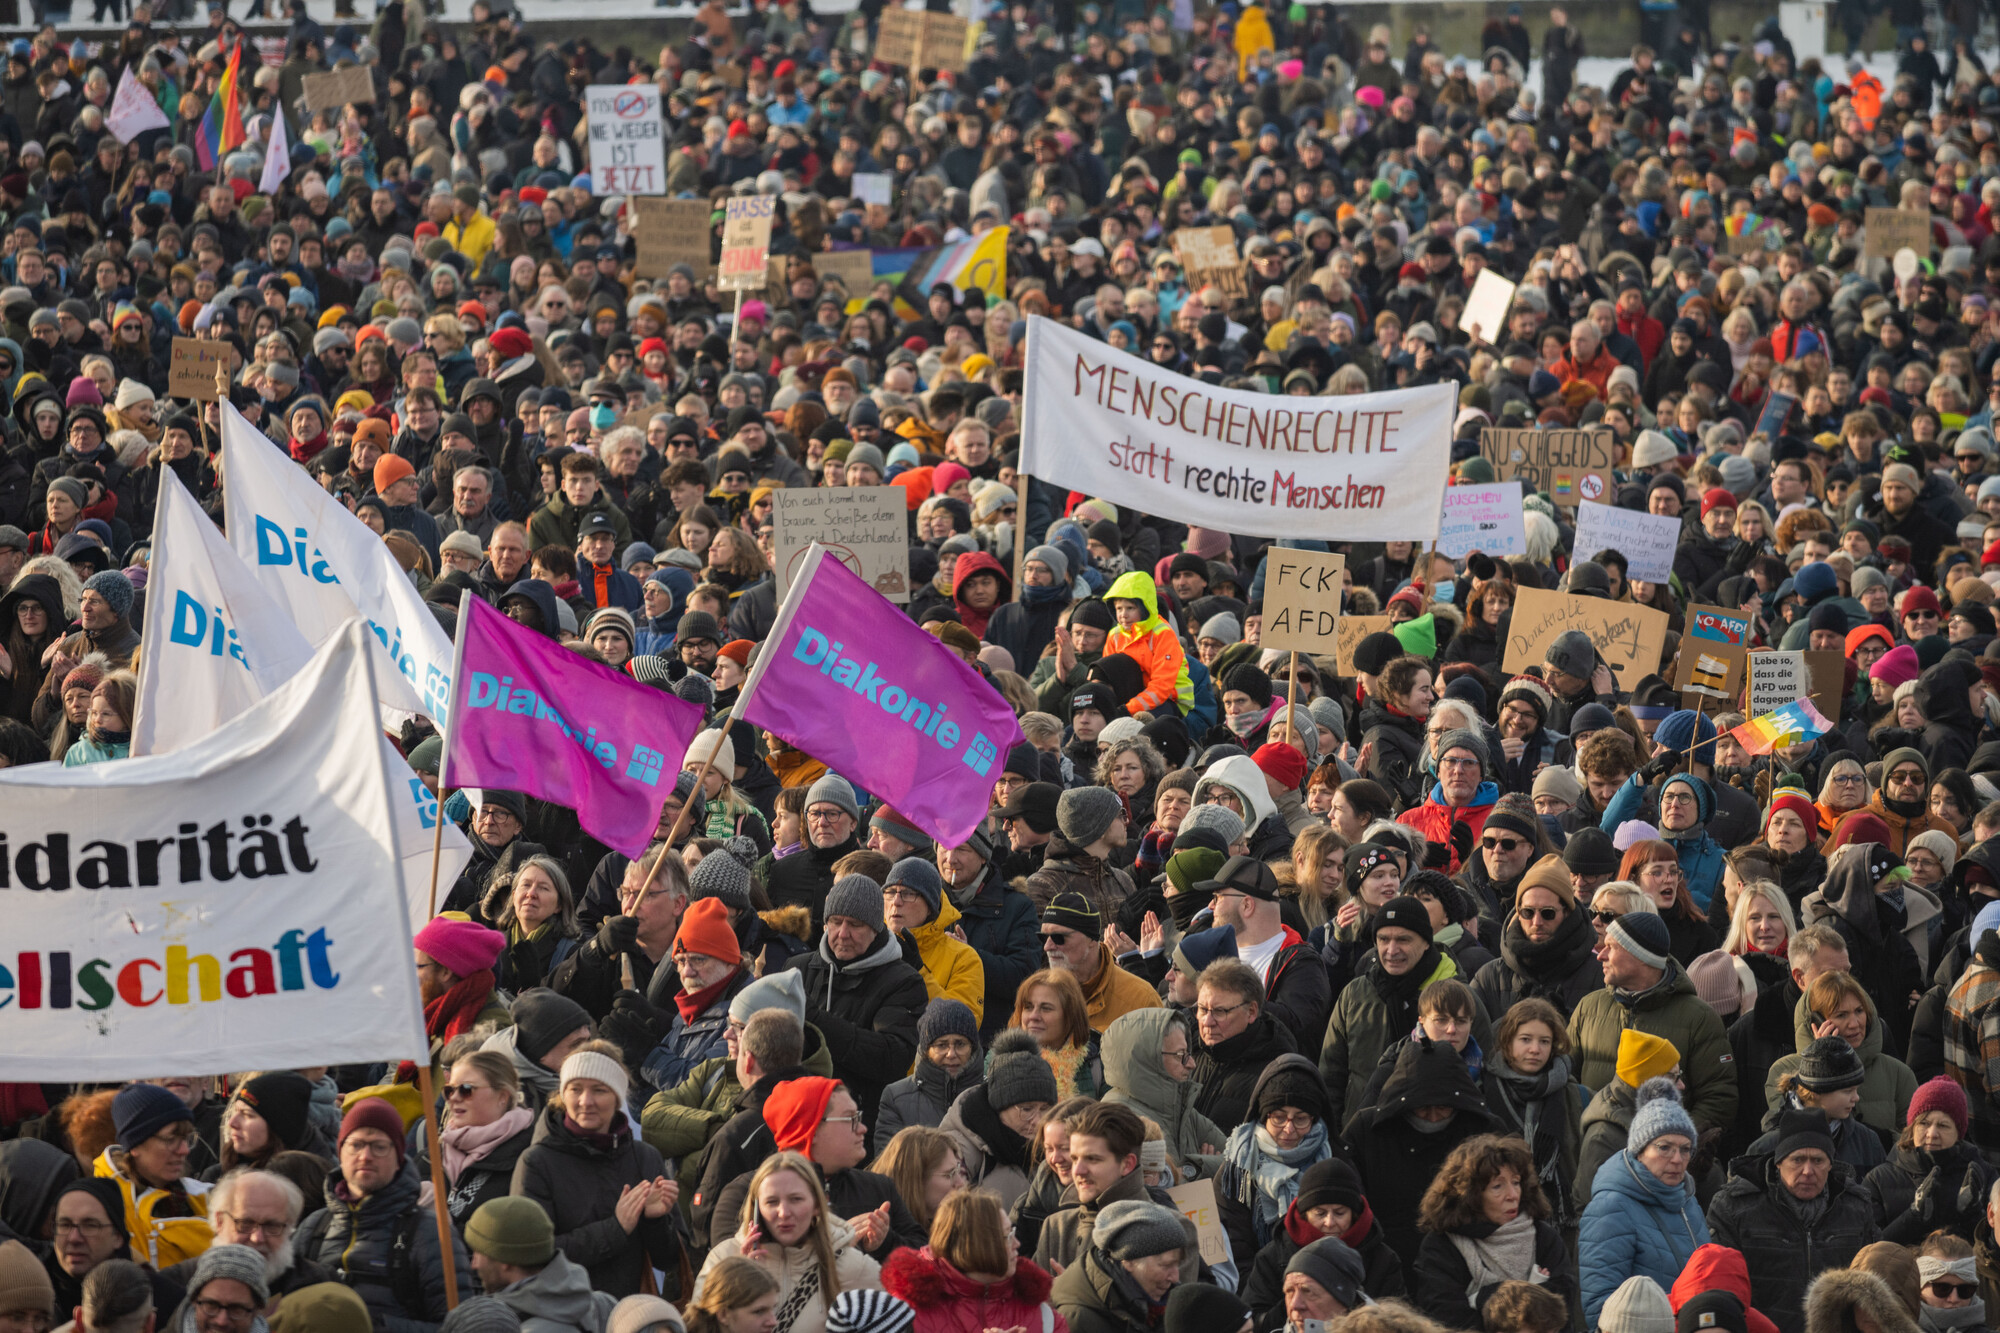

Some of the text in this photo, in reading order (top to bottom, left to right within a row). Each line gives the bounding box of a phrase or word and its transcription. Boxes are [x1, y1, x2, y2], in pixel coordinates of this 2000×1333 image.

[612, 121, 659, 140] WIEDER
[612, 143, 637, 164] IST
[600, 165, 655, 192] JETZT
[727, 196, 773, 220] HASS
[1075, 353, 1403, 454] MENSCHENRECHTE
[1481, 430, 1511, 466] NU
[1108, 435, 1386, 511] statt rechte Menschen
[776, 489, 878, 509] Von euch kommt nur
[1444, 492, 1502, 507] ENSCHEN
[781, 510, 817, 527] braune
[872, 508, 895, 522] denn
[1580, 504, 1600, 525] Die
[783, 529, 797, 546] ihr
[803, 530, 825, 545] seid
[1278, 563, 1338, 593] FCK
[1270, 606, 1335, 636] AFD
[1695, 614, 1748, 635] NO AFD!
[1754, 656, 1793, 666] Lebe so,
[1754, 669, 1793, 679] dass die
[792, 625, 961, 749] Diakonie
[1754, 683, 1776, 692] AFD
[1753, 695, 1796, 705] dagegen
